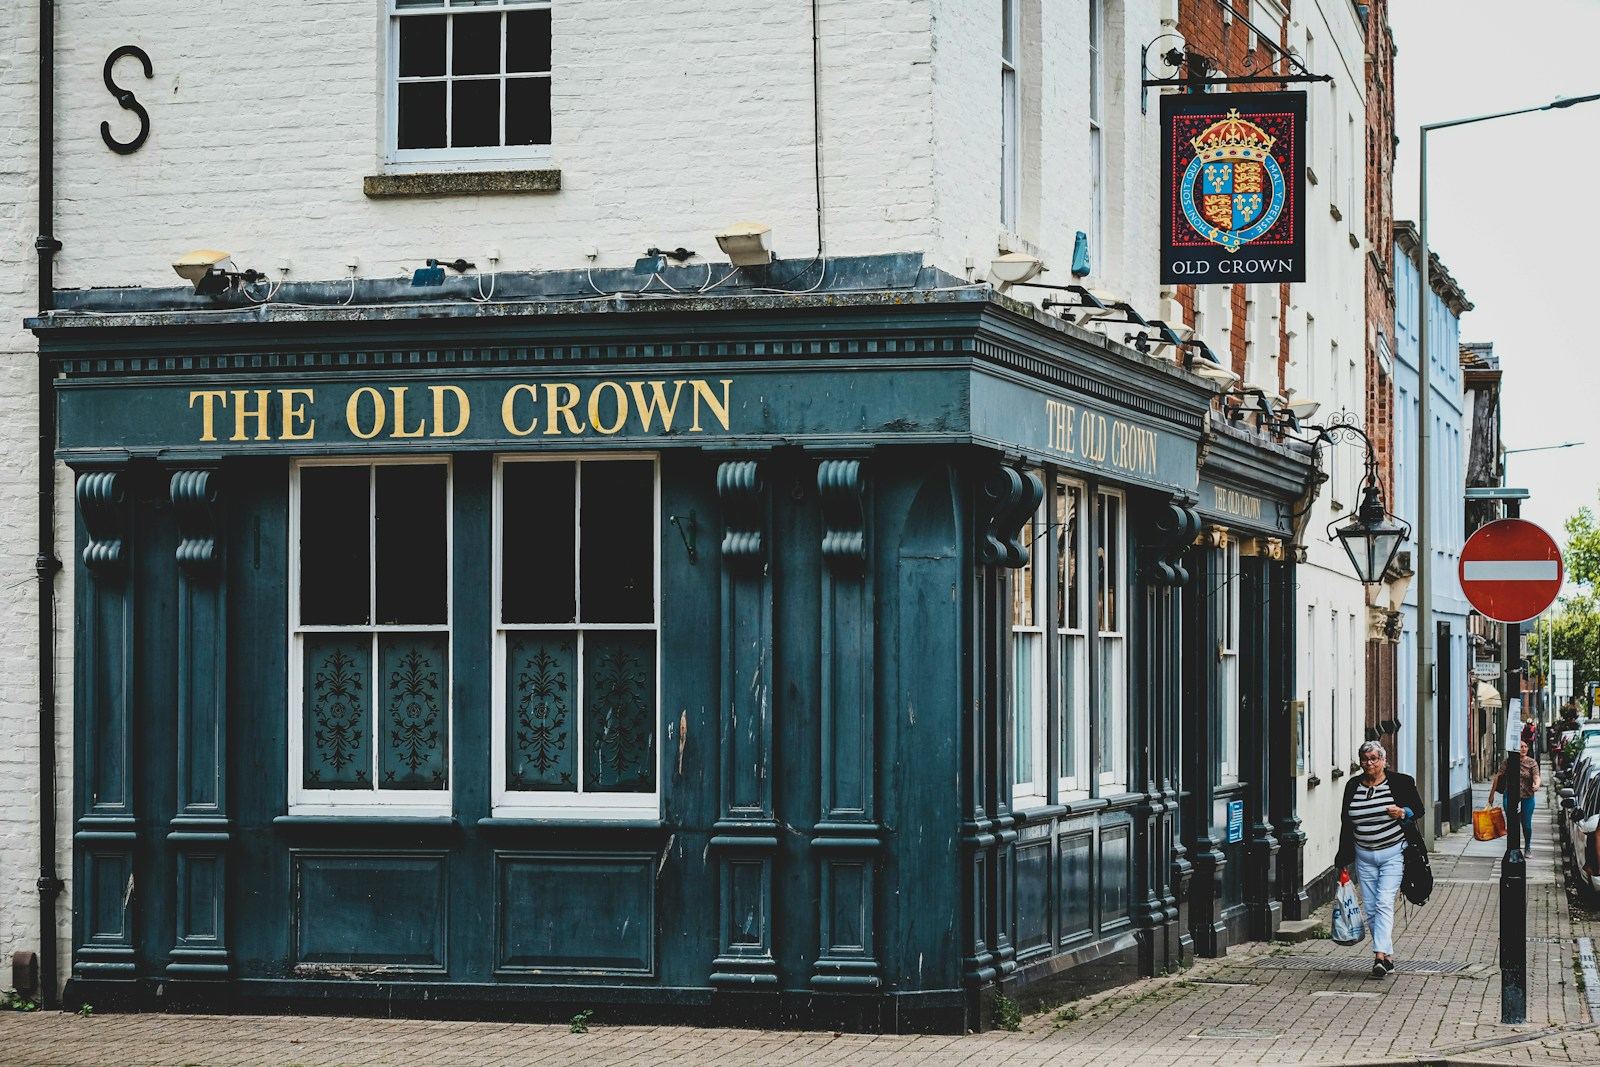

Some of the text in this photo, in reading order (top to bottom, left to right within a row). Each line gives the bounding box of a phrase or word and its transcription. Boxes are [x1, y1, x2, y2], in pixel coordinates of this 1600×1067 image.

[1186, 162, 1199, 180] QUI
[1269, 163, 1281, 186] MAL
[1183, 182, 1192, 205] SOIT
[1188, 209, 1207, 232] HONI
[1255, 204, 1280, 233] PENSE
[1172, 258, 1293, 274] OLD CROWN
[189, 379, 733, 442] THE OLD CROWN
[1046, 399, 1158, 475] THE OLD CROWN
[1215, 485, 1260, 520] THE OLD CROWN
